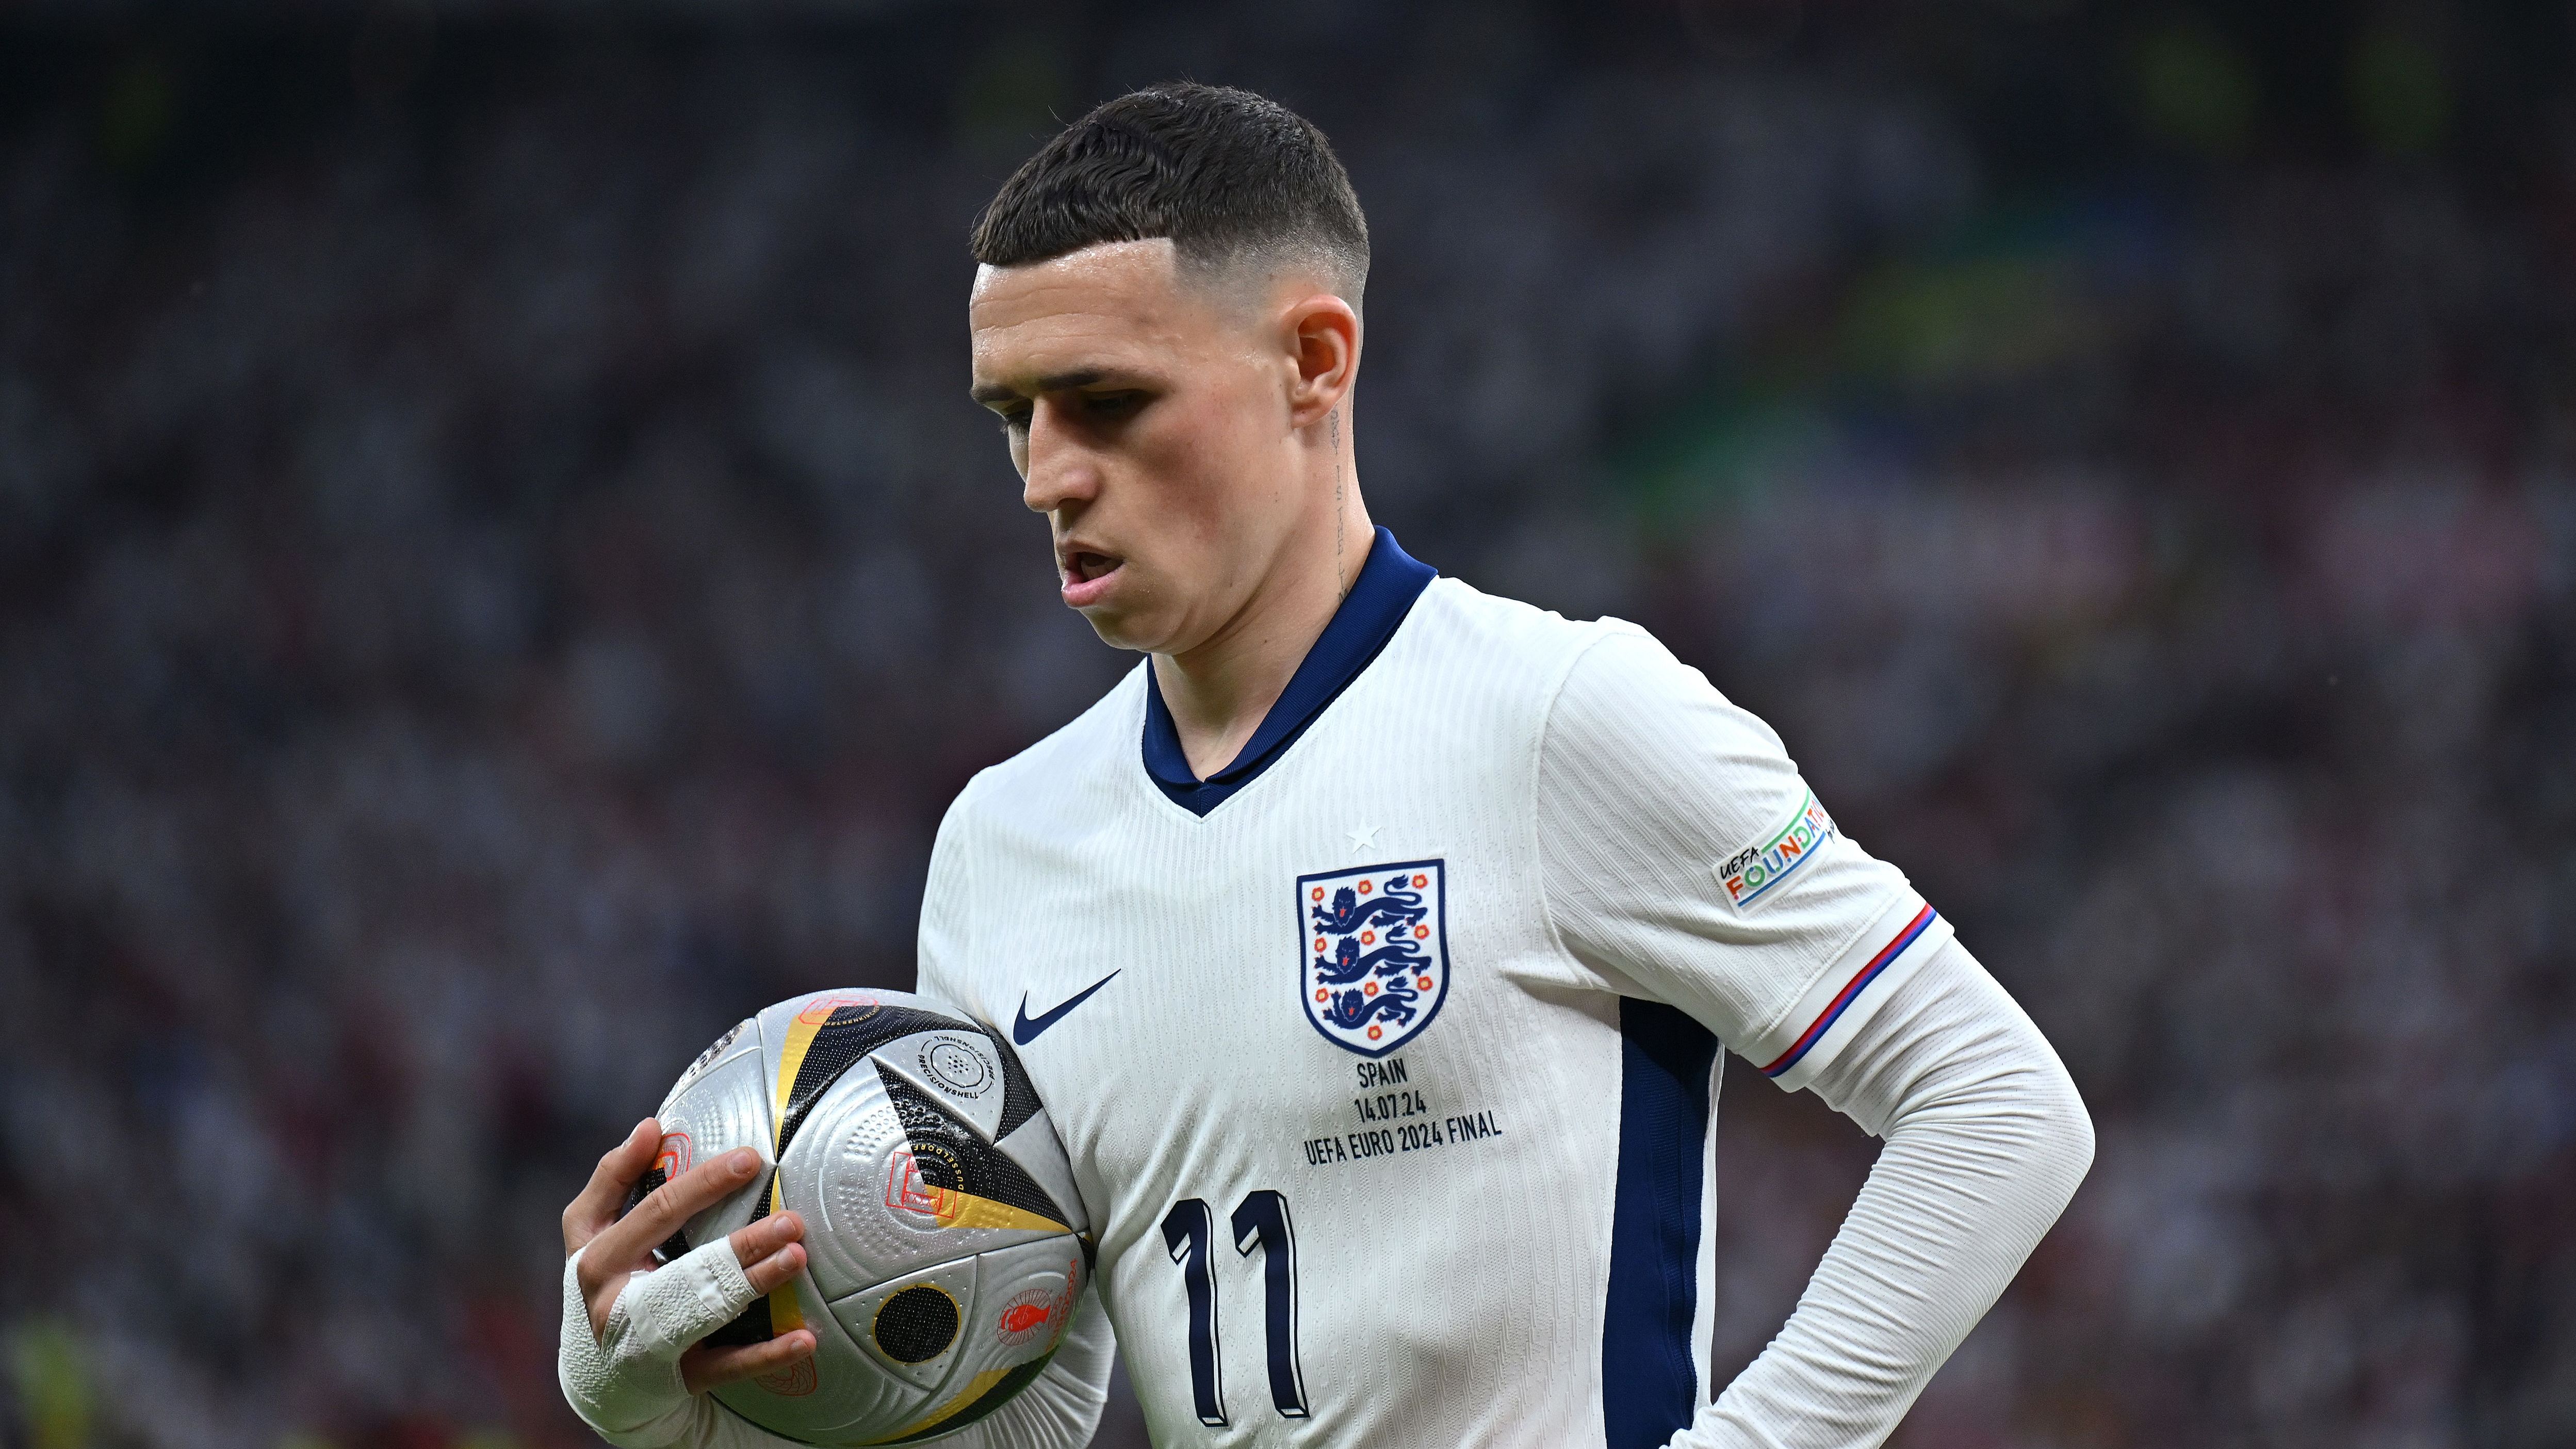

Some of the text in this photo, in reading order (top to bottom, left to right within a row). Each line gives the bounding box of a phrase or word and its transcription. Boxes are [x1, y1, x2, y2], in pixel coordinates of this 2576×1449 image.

[1720, 846, 1760, 880] UEFA
[918, 1054, 979, 1099] PRECISIONSHELL
[1356, 1058, 1408, 1088] SPAIN
[1354, 1090, 1426, 1123] 14.07.24
[1304, 1110, 1502, 1166] UEFA EURO 2024 FINAL
[1160, 1190, 1310, 1427] 11
